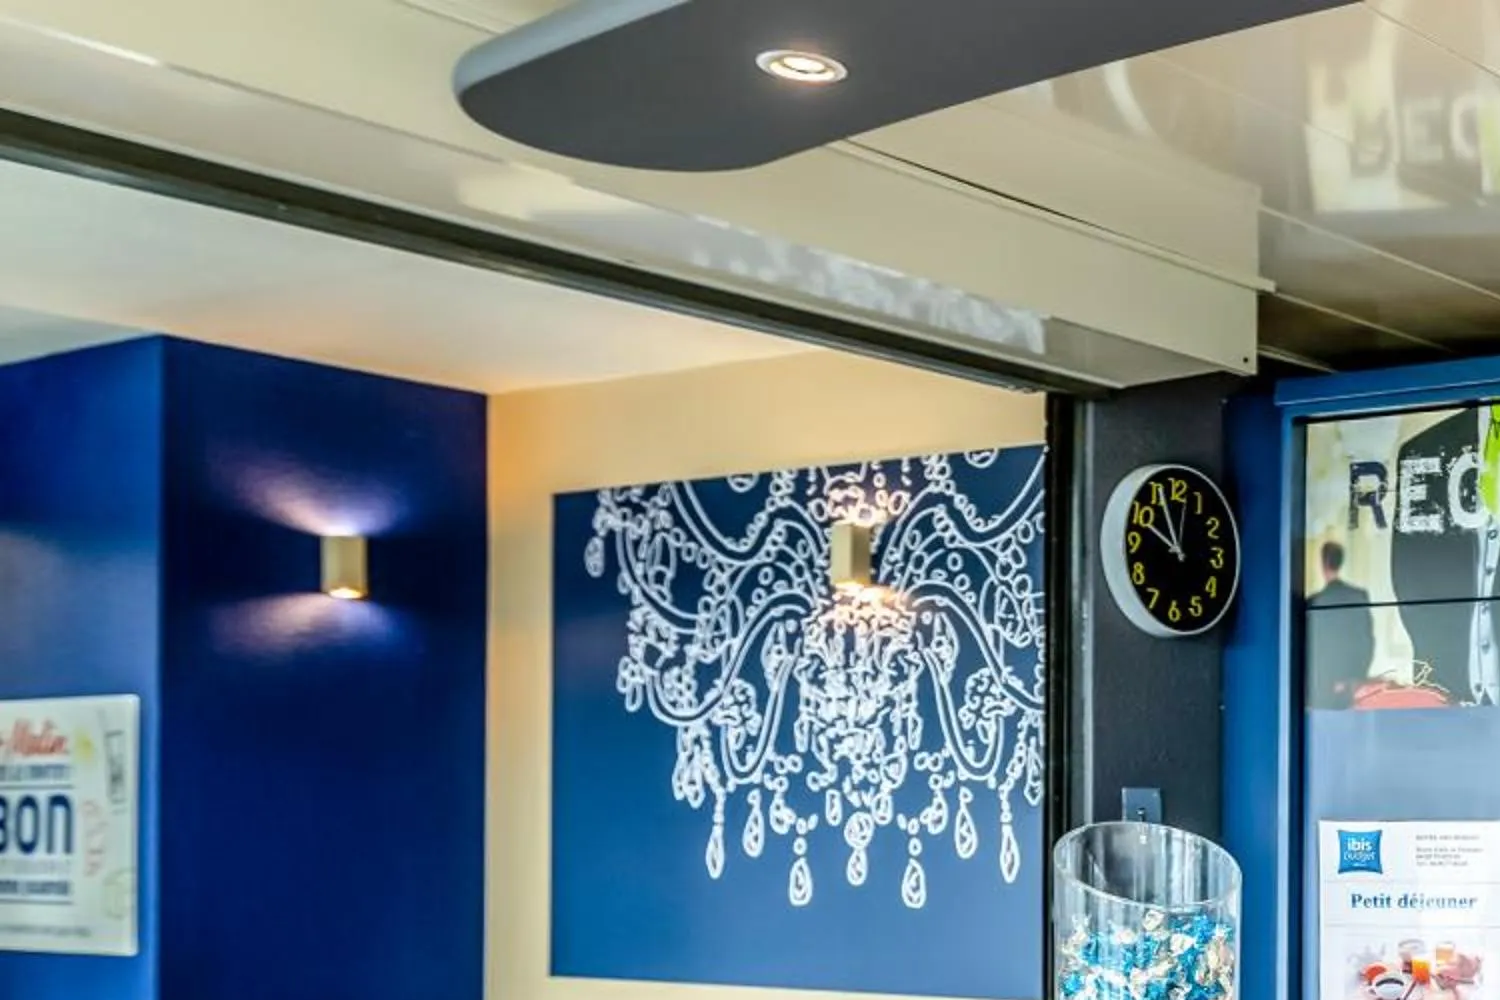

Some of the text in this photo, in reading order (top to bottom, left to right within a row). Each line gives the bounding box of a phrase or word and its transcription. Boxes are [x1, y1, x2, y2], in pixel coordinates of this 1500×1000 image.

[1168, 478, 1187, 503] 12
[1194, 492, 1203, 514] 1
[1132, 501, 1154, 528] 10
[1205, 517, 1220, 539] 2
[1127, 531, 1142, 554] 9
[1209, 547, 1224, 569] 3
[1132, 562, 1145, 585] 8
[1146, 587, 1160, 609] 7
[1205, 576, 1217, 598] 4
[1168, 600, 1181, 622] 6
[1188, 596, 1203, 617] 5
[1346, 836, 1373, 850] ibis
[1343, 850, 1376, 863] budget
[1351, 892, 1478, 912] Petit déjeuner
